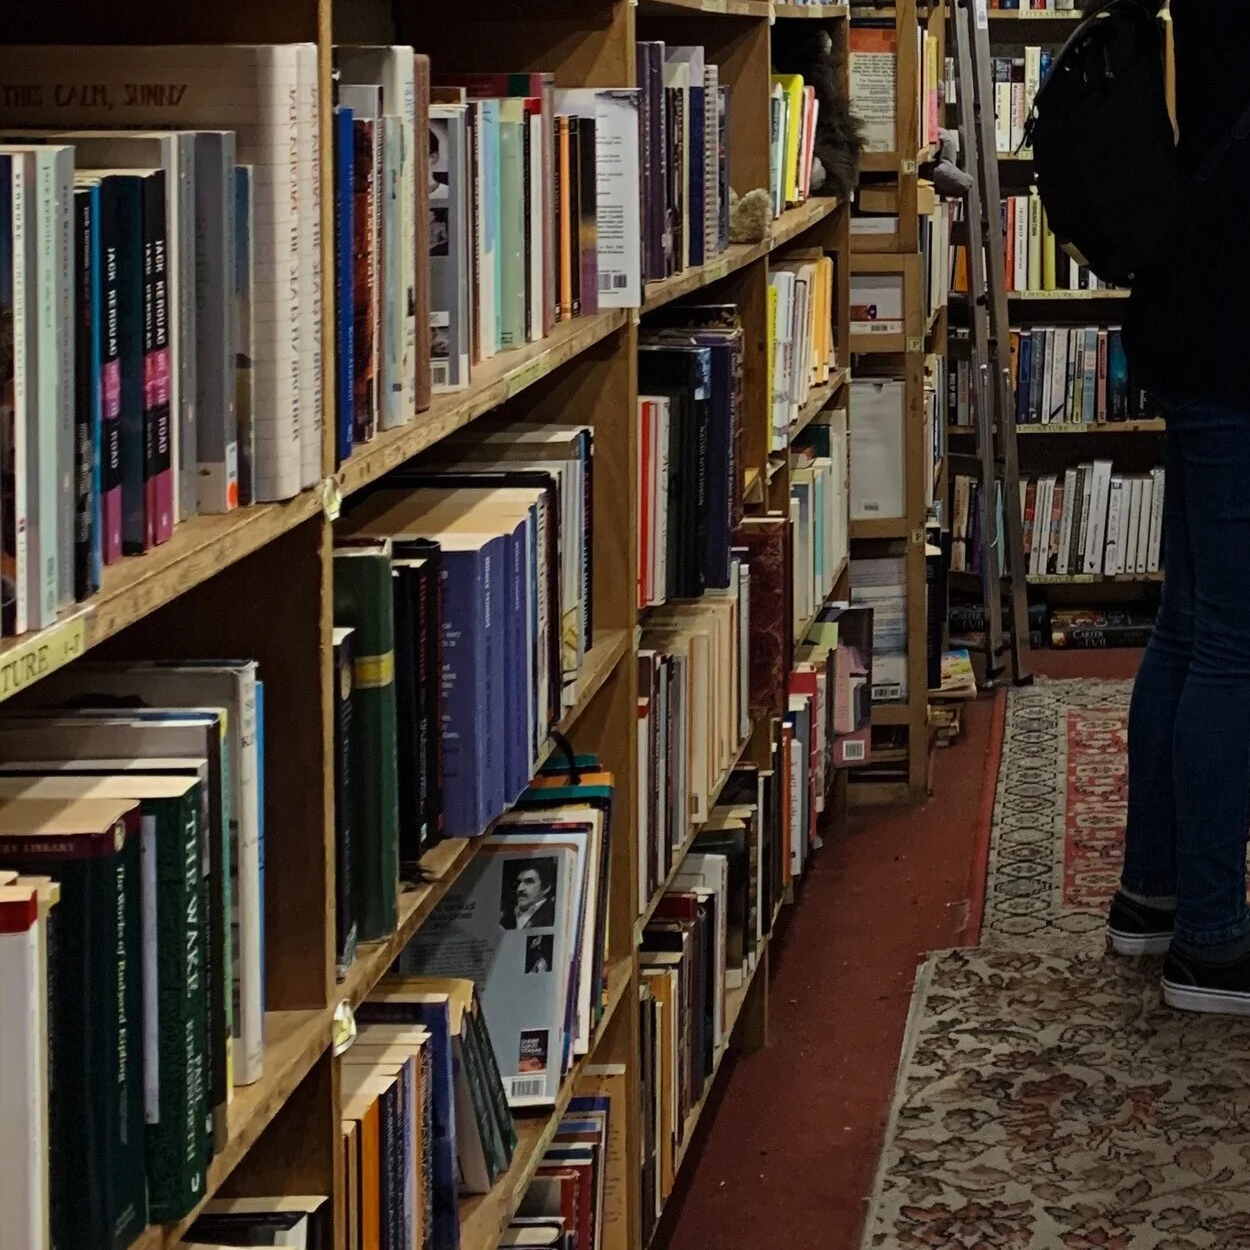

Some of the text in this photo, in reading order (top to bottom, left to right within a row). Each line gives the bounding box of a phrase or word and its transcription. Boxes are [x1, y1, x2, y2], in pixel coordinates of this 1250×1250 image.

[3, 83, 44, 107] THIS
[124, 82, 189, 107] SUNNY
[106, 247, 119, 469] JACK KEROUAC ROAD
[154, 240, 169, 454] JACK KEROUAC ROAD
[116, 864, 126, 887] The
[186, 809, 199, 999] THE WAKE
[116, 892, 126, 938] Works
[116, 960, 126, 1024] Rudyard
[116, 1028, 127, 1084] Kipling
